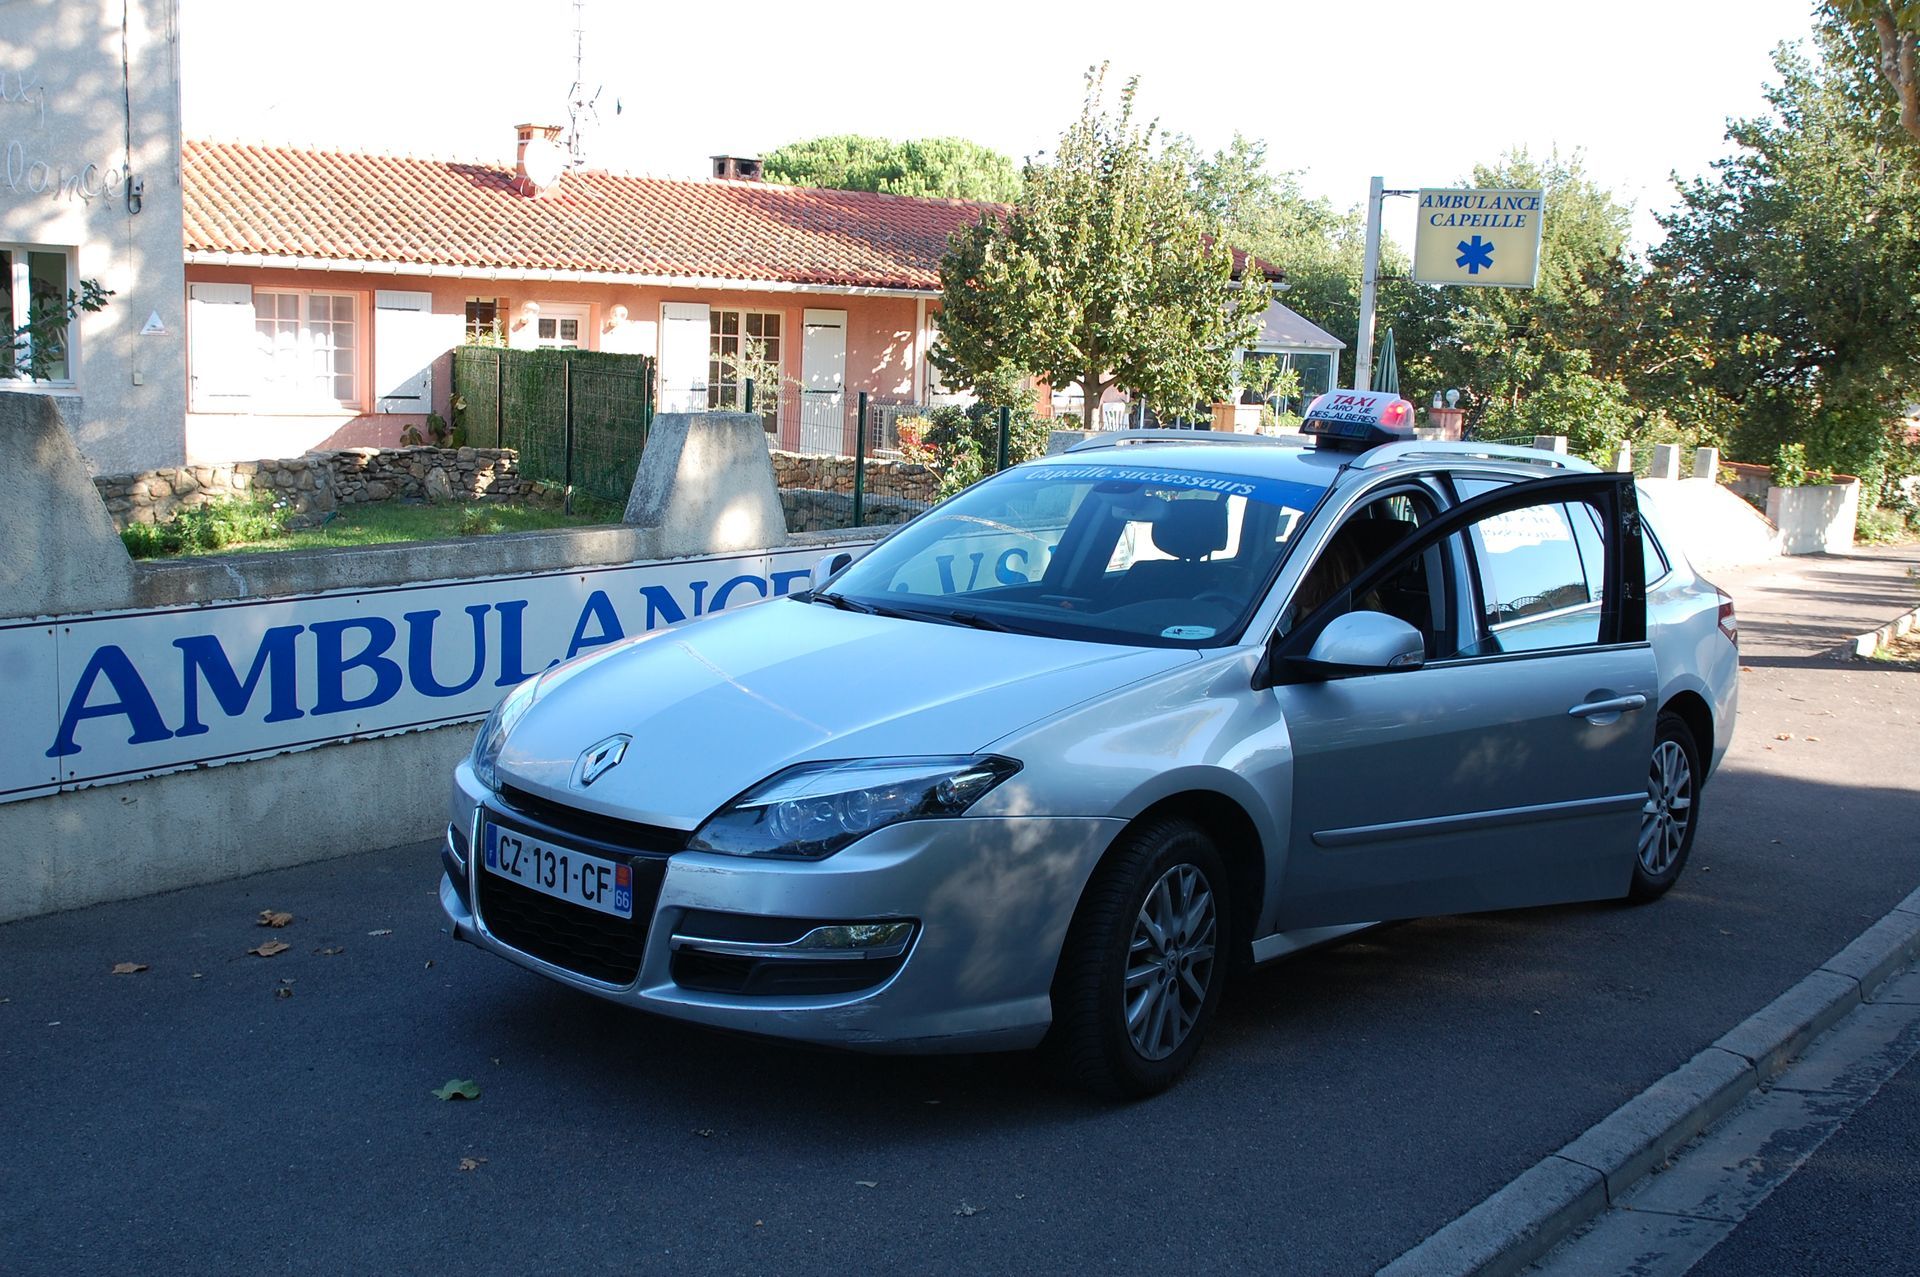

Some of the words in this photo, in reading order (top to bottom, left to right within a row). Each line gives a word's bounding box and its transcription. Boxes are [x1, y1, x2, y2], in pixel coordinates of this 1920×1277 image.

[1420, 194, 1540, 211] AMBULANCE
[1430, 213, 1527, 228] CAPEILLE
[1333, 394, 1377, 407] TAXI
[1114, 468, 1256, 495] successeurs
[936, 545, 1057, 595] VS
[616, 889, 630, 909] 66
